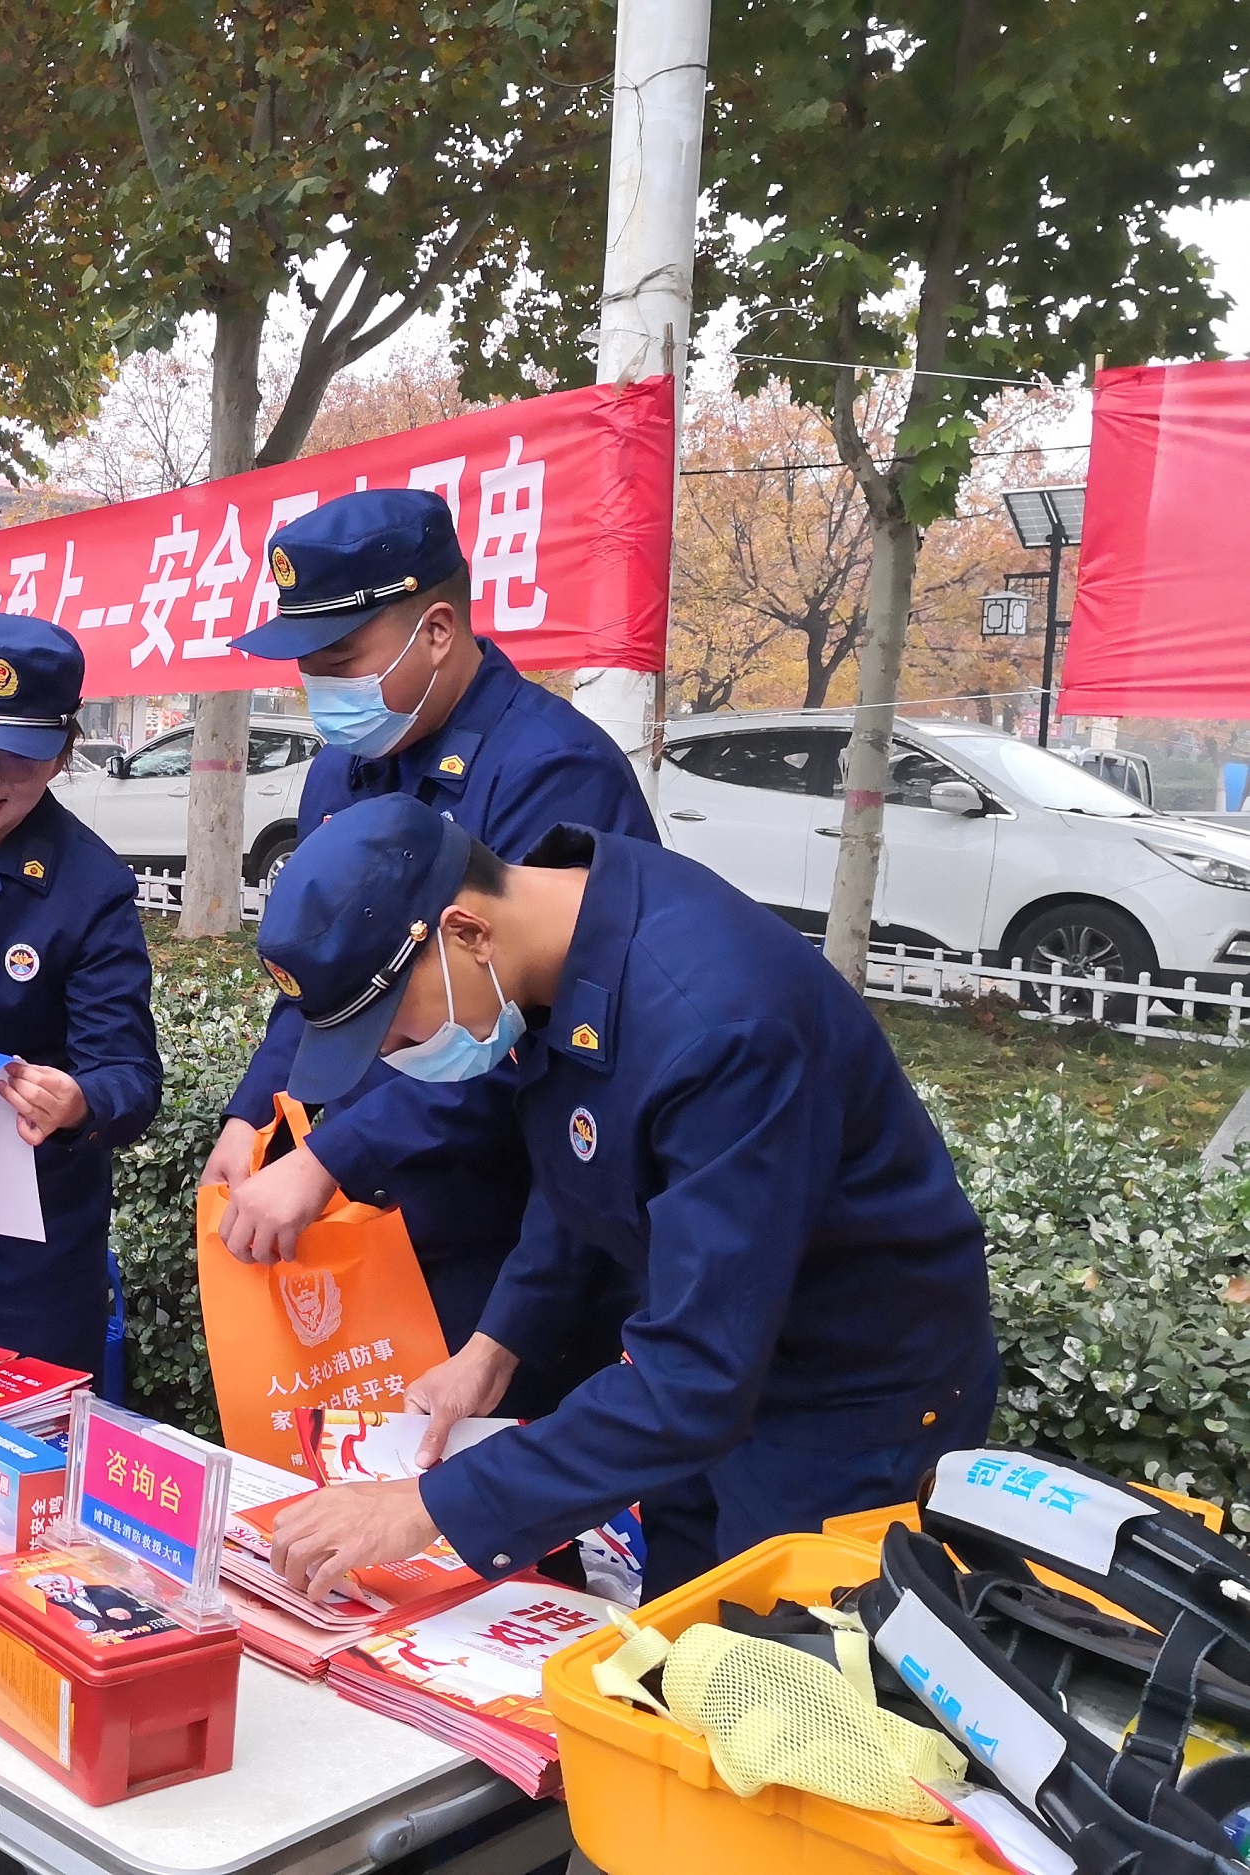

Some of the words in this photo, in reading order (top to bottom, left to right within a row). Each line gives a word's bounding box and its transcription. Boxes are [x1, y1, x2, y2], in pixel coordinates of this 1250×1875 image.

[266, 1337, 396, 1397] 人人关心消防事
[270, 1373, 406, 1431] 家户户保平安
[105, 1448, 183, 1515] 咨询台
[290, 1453, 308, 1467] 博
[93, 1508, 183, 1567] 博野县消防救援大队
